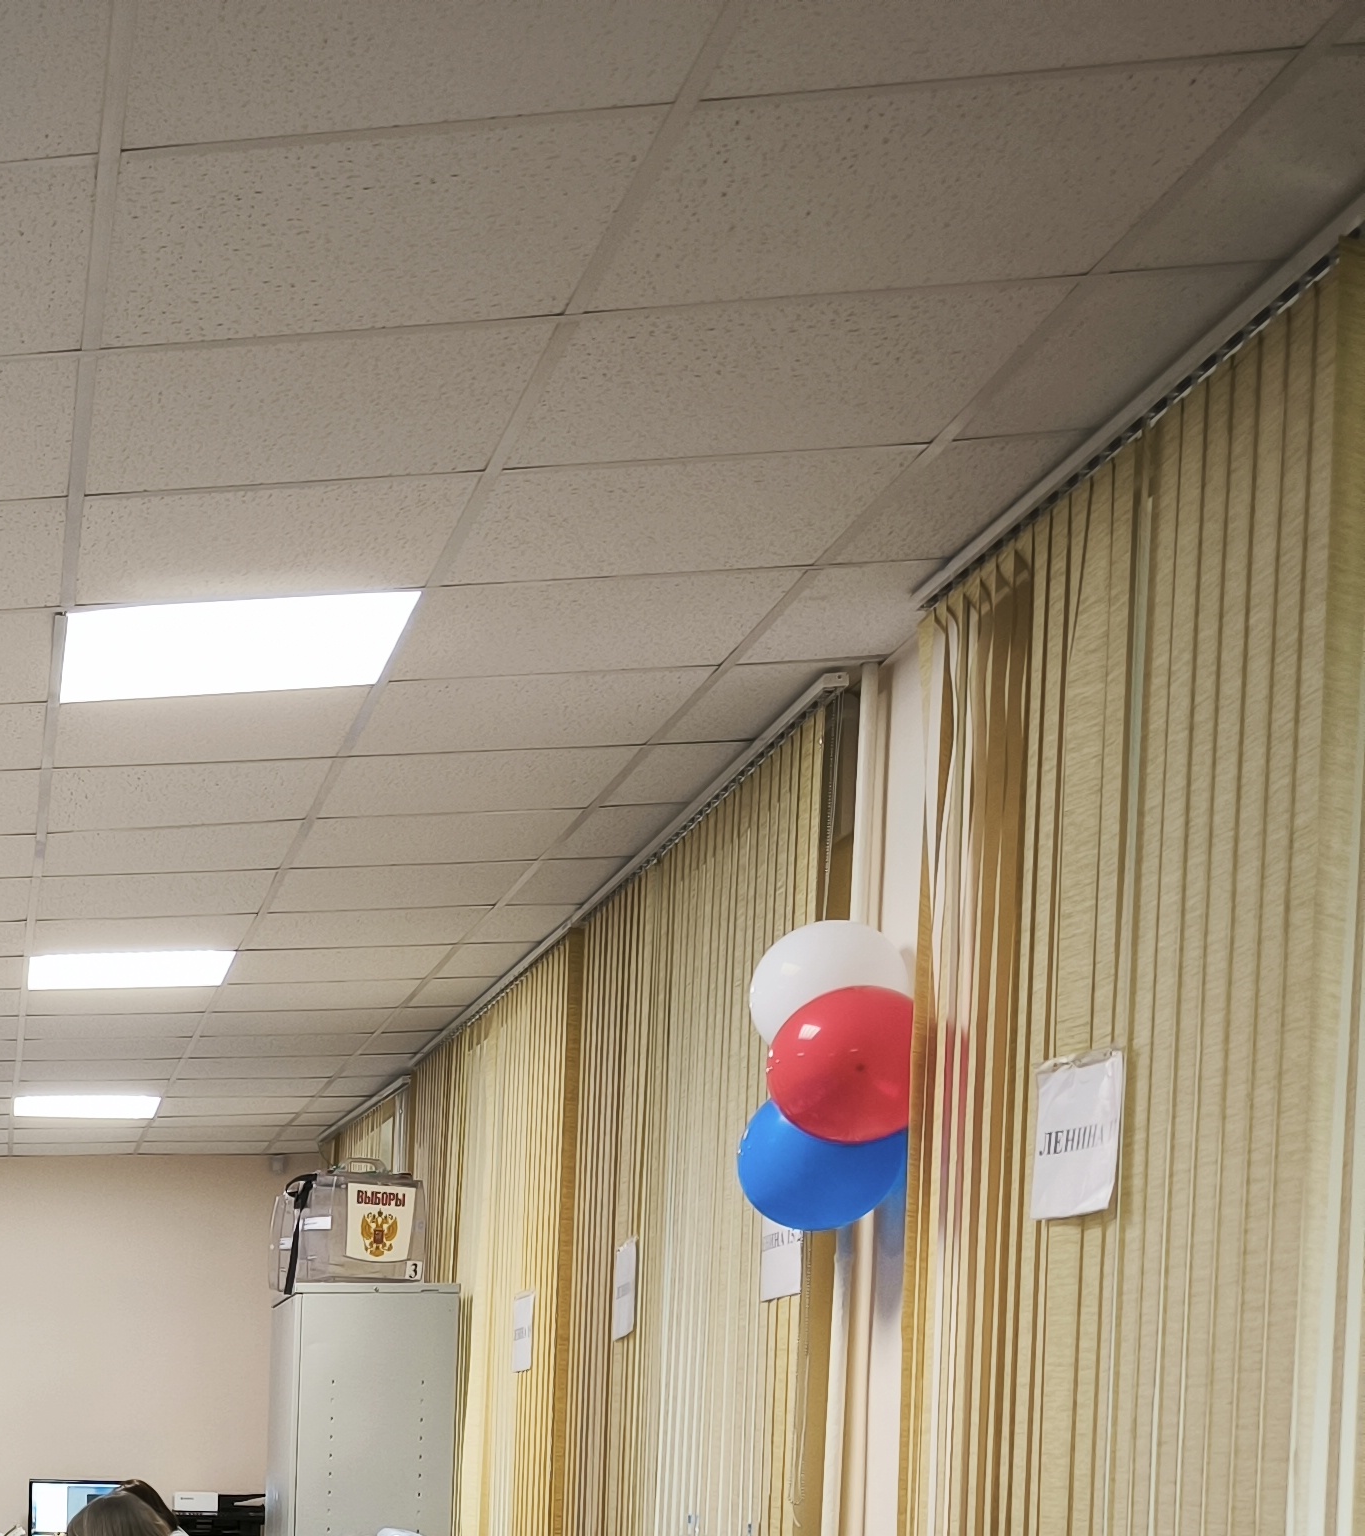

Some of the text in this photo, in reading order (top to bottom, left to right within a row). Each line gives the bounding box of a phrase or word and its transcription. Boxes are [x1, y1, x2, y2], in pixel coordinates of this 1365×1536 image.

[1039, 1124, 1104, 1156] ЛЕНИНА
[356, 1189, 406, 1207] ВЫБОРЫ
[409, 1263, 418, 1279] 3
